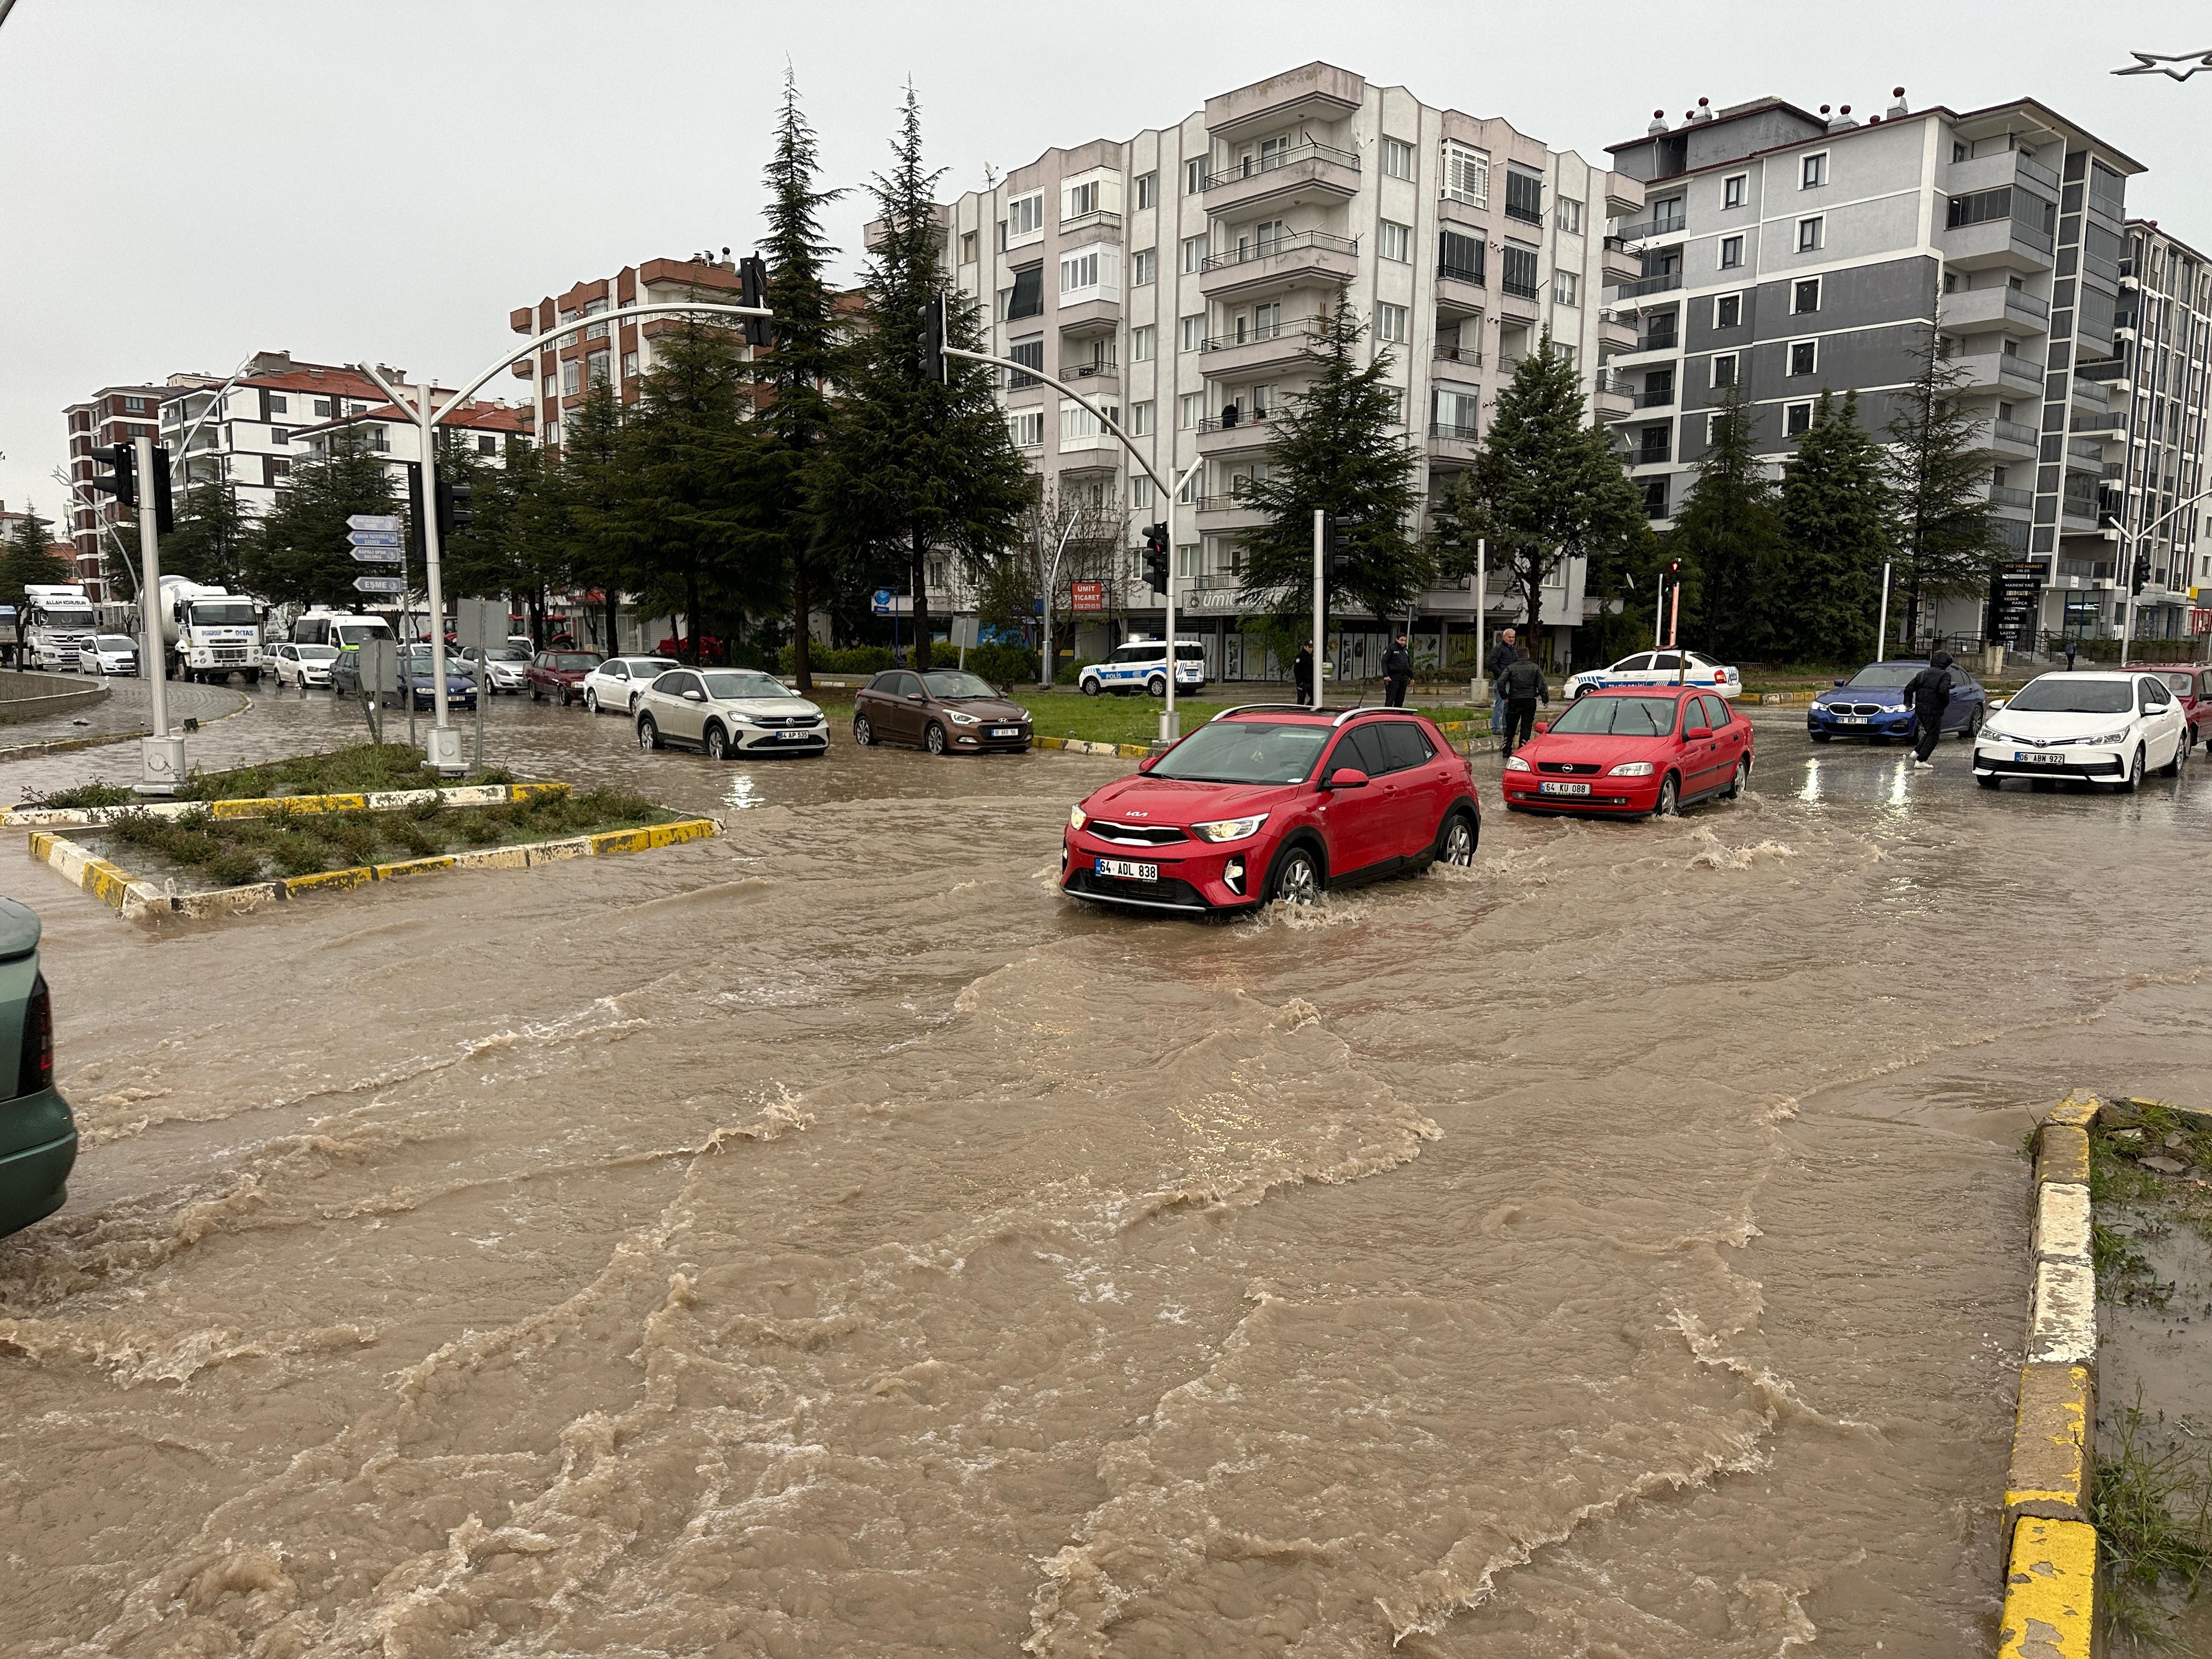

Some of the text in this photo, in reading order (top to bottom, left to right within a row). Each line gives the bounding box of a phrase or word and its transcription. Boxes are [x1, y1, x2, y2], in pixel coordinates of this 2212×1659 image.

[364, 581, 387, 590] EŞME
[1203, 590, 1235, 607] ümit
[1572, 785, 1585, 793] 088
[1100, 860, 1111, 873] 64
[1118, 862, 1134, 876] ADL
[1139, 865, 1155, 878] 838
